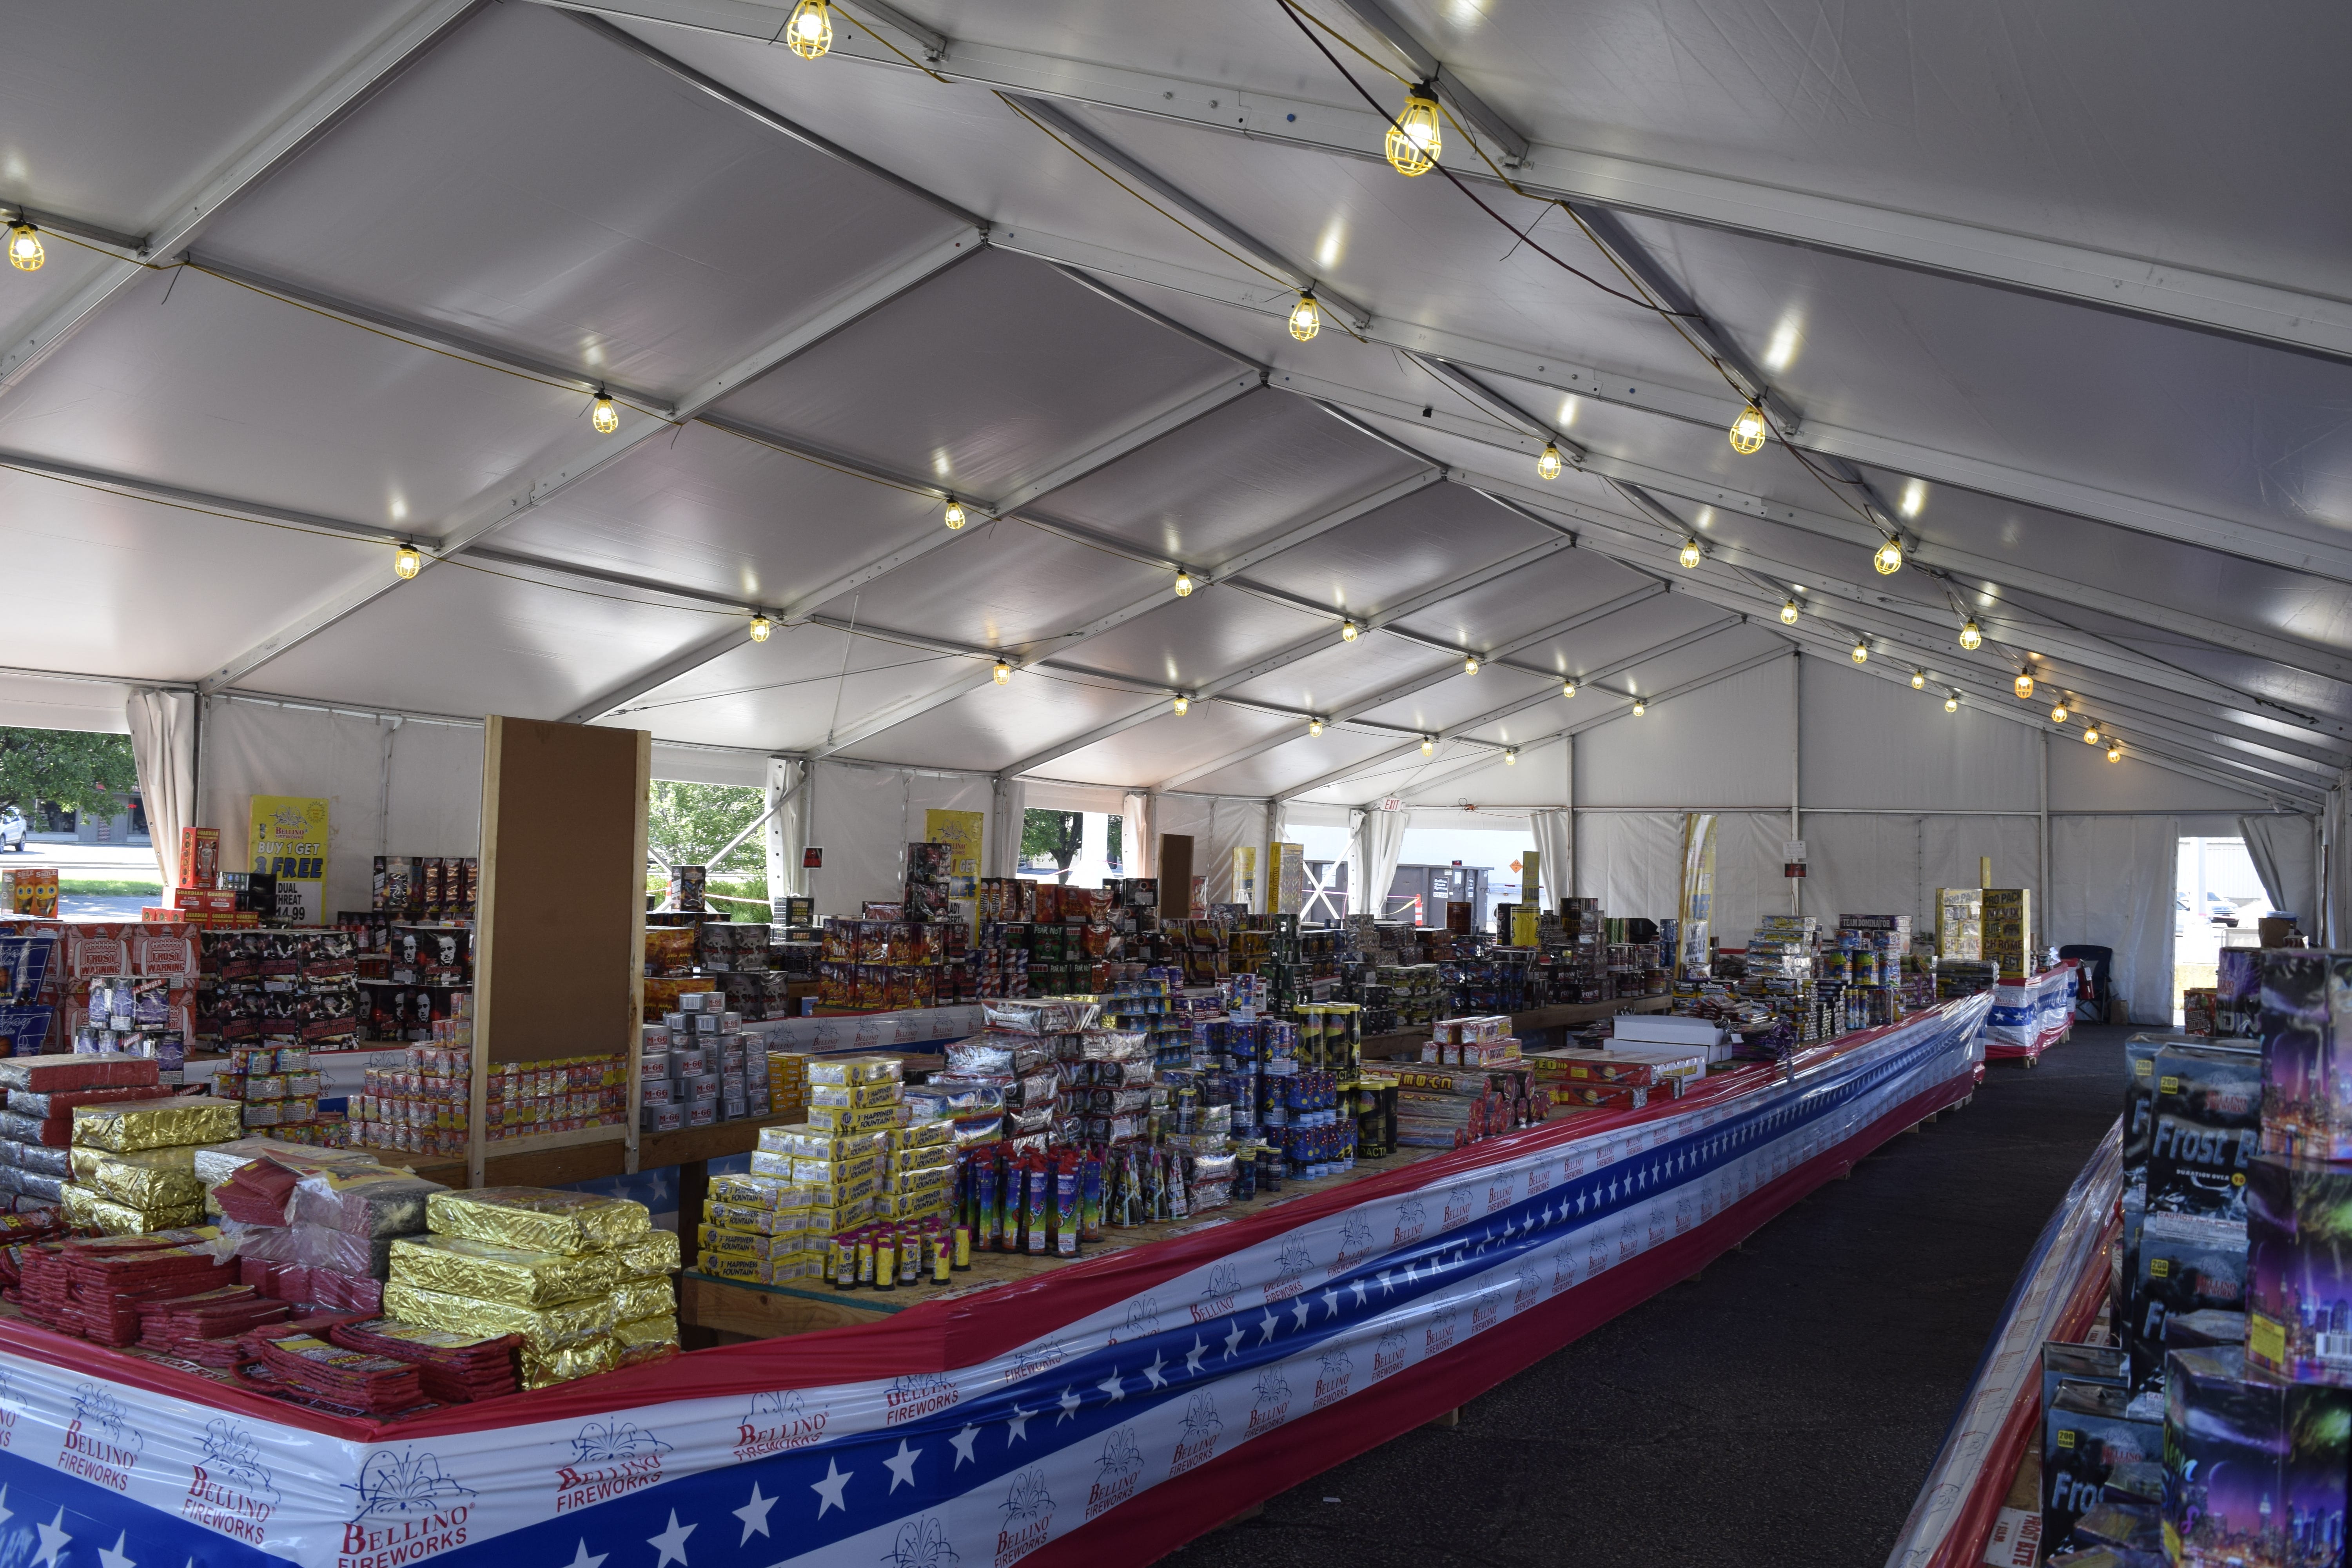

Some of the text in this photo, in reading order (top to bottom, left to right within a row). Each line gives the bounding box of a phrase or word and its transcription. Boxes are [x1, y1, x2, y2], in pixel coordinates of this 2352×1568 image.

[1385, 799, 1400, 810] EXIT
[258, 842, 320, 855] BUY 1 GET
[255, 856, 323, 878] 3 FREE
[952, 859, 976, 873] 1 GET
[278, 883, 298, 893] DUAL
[1984, 892, 2022, 905] PRO PACK
[950, 902, 960, 914] ADY
[1843, 918, 1890, 927] TEAM DOMINATOR
[1034, 926, 1063, 935] FEAR NOT
[86, 952, 117, 964] FROST
[151, 949, 182, 962] FROST
[80, 964, 121, 975] WARNING
[147, 962, 185, 973] WARNING
[1058, 964, 1067, 973] NOT
[140, 979, 162, 992] DANGER
[302, 1022, 356, 1042] HAYMAKER
[126, 1034, 140, 1046] DANGER
[179, 1085, 200, 1096] DANGER
[869, 1093, 889, 1105] FOUNTAIN
[659, 1113, 680, 1122] M-66
[864, 1109, 894, 1120] HAPPINESS
[860, 1117, 891, 1128] FOUNTAIN
[916, 1134, 939, 1145] FOUNTAIN
[850, 1143, 872, 1156] FOUNTAIN
[853, 1157, 874, 1171] HAPPINESS
[916, 1156, 941, 1168] FOUNTAIN
[1529, 1171, 1550, 1187] BELLINO
[2176, 1169, 2210, 1178] DURATION
[916, 1178, 940, 1189] FOUNTAIN
[1528, 1181, 1549, 1196] FIREWORKS
[1489, 1187, 1512, 1203] BELLINO
[914, 1197, 938, 1211] FOUNTAIN
[1487, 1197, 1511, 1214] FIREWORKS
[1444, 1203, 1470, 1223] BELLINO
[2159, 1212, 2193, 1221] CAUTION
[1394, 1223, 1423, 1244] BELLINO
[1472, 1316, 1497, 1334] FIREWORKS
[1425, 1337, 1453, 1357] FIREWORKS
[1374, 1348, 1405, 1371] BELLINO
[1372, 1361, 1404, 1382] FIREWORKS
[1315, 1374, 1350, 1399] BELLINO
[1313, 1387, 1348, 1410] FIREWORKS
[886, 1390, 960, 1425] FIREWORKS
[1249, 1402, 1288, 1428] BELLINO
[733, 1412, 827, 1448] BELLINO
[63, 1418, 135, 1471] BELLINO
[58, 1450, 128, 1491] FIREWORKS
[1169, 1449, 1214, 1477] FIREWORKS
[555, 1455, 662, 1493] BELLINO
[187, 1464, 272, 1523] BELLINO
[556, 1470, 663, 1514] FIREWORKS
[1087, 1472, 1138, 1506] BELLINO
[1085, 1486, 1133, 1521] FIREWORKS
[181, 1498, 265, 1545] FIREWORKS
[995, 1516, 1049, 1557] BELLINO
[2012, 1515, 2041, 1567] FROST BITE
[995, 1532, 1048, 1568] FIREWORKS
